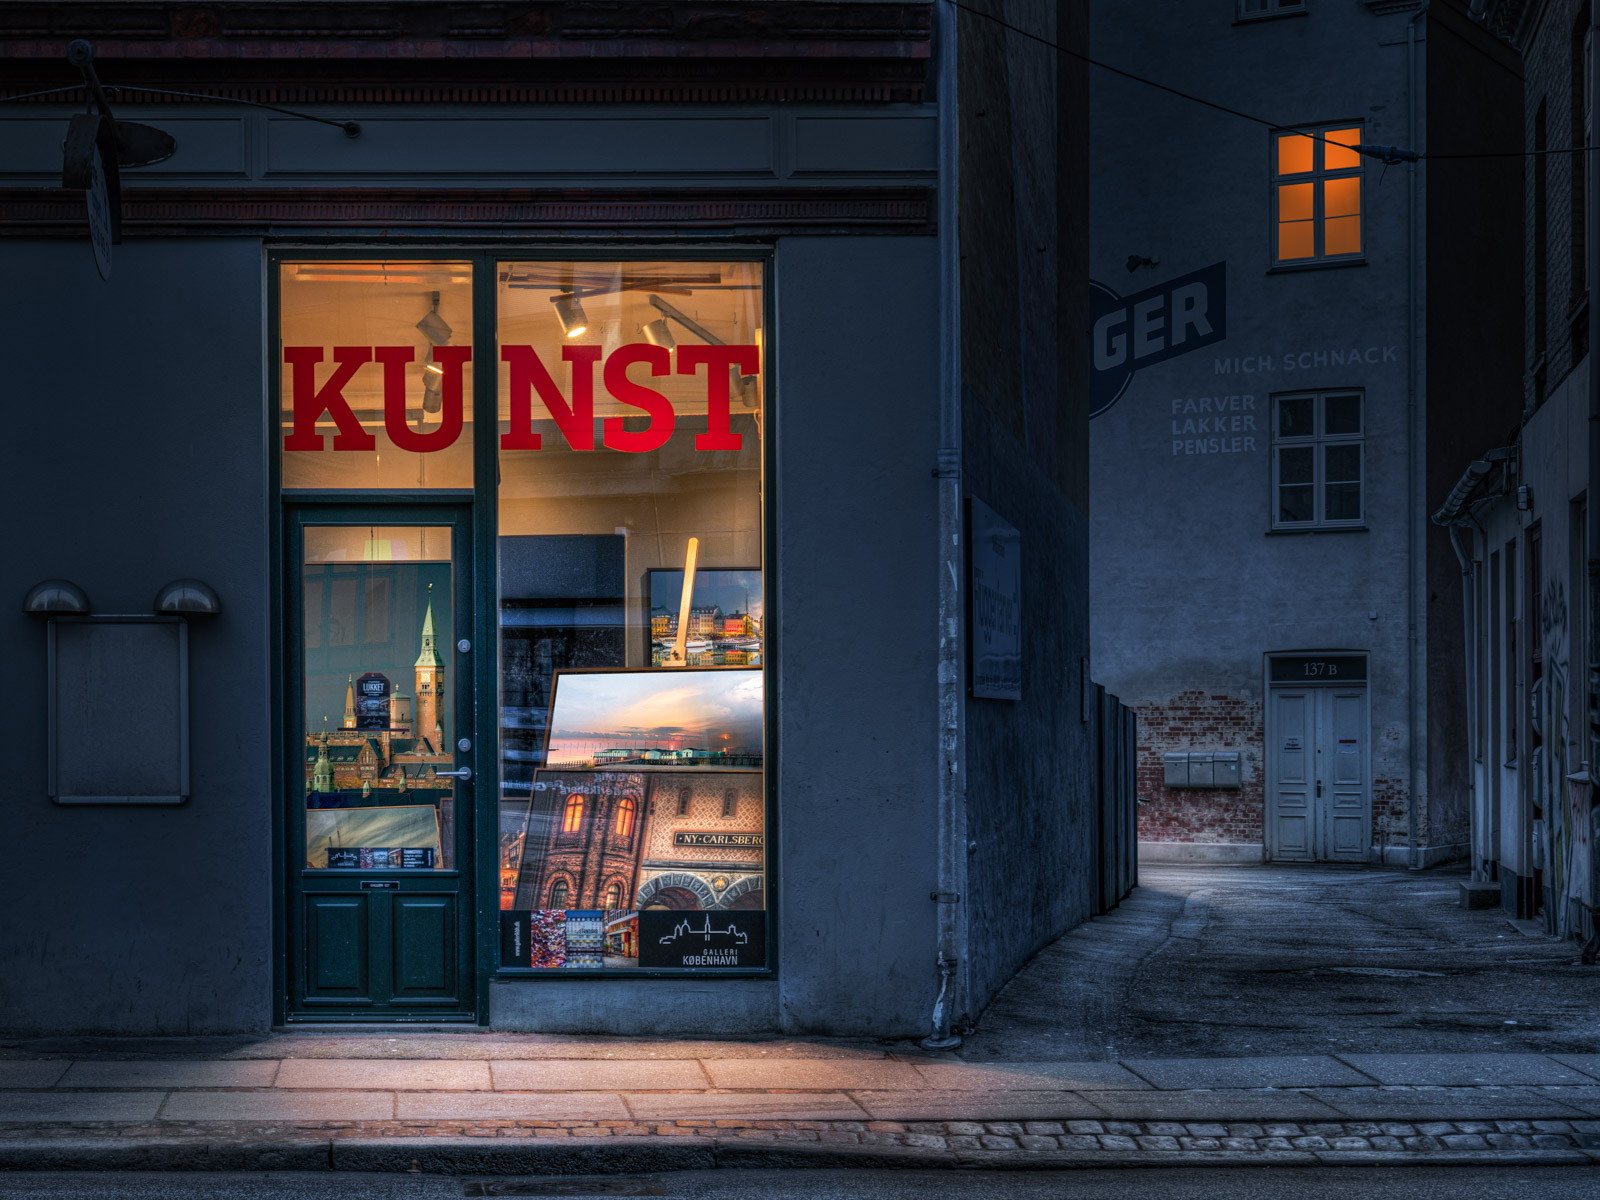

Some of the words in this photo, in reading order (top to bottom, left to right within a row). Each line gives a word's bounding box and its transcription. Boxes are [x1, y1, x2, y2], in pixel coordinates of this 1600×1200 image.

[1093, 281, 1214, 372] GER
[1283, 345, 1397, 371] SCHNACK
[283, 343, 760, 453] KUNST
[1172, 395, 1256, 415] FARVER
[1172, 415, 1257, 435] LAKKER
[1172, 437, 1257, 455] PENSLER
[1303, 662, 1325, 676] 137
[1328, 664, 1338, 675] B
[682, 955, 738, 966] KØBENHAVN
[703, 948, 738, 956] GALLERI
